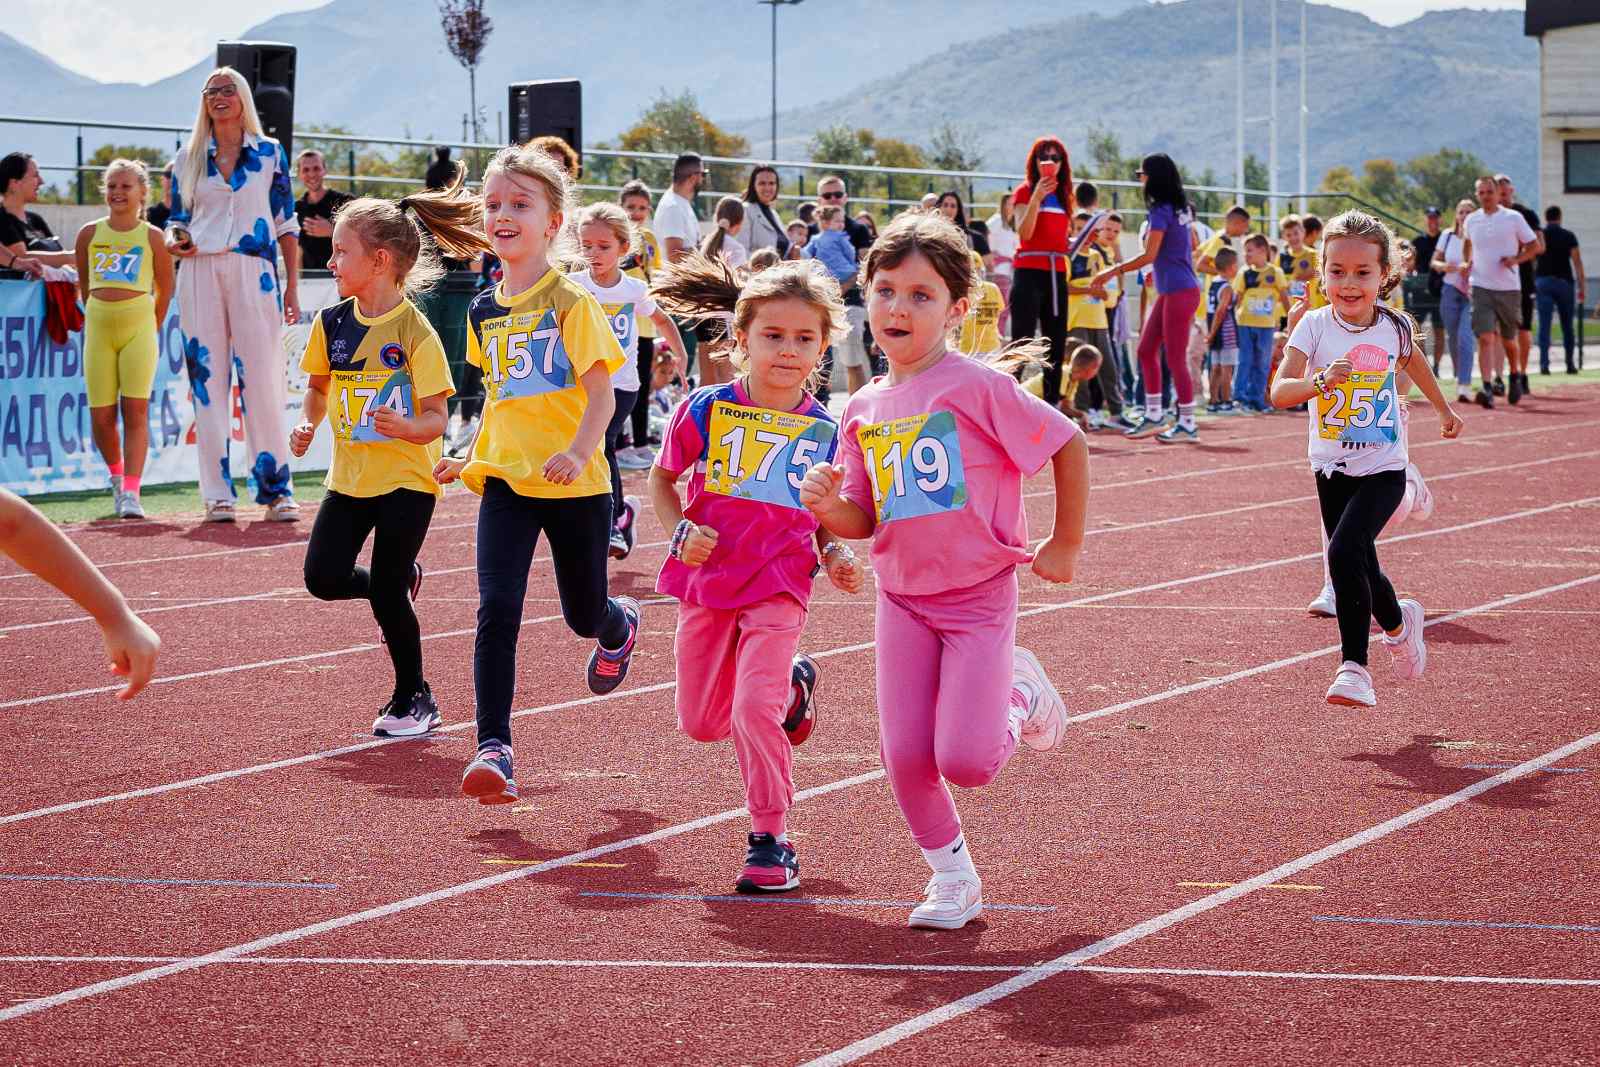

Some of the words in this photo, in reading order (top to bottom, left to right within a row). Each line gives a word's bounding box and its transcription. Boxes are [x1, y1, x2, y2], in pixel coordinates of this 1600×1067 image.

[95, 252, 138, 274] 237
[484, 327, 560, 383] 157
[340, 385, 408, 428] 174
[719, 406, 761, 421] TROPIC
[1322, 388, 1394, 429] 252
[720, 426, 820, 489] 175
[866, 435, 951, 502] 119
